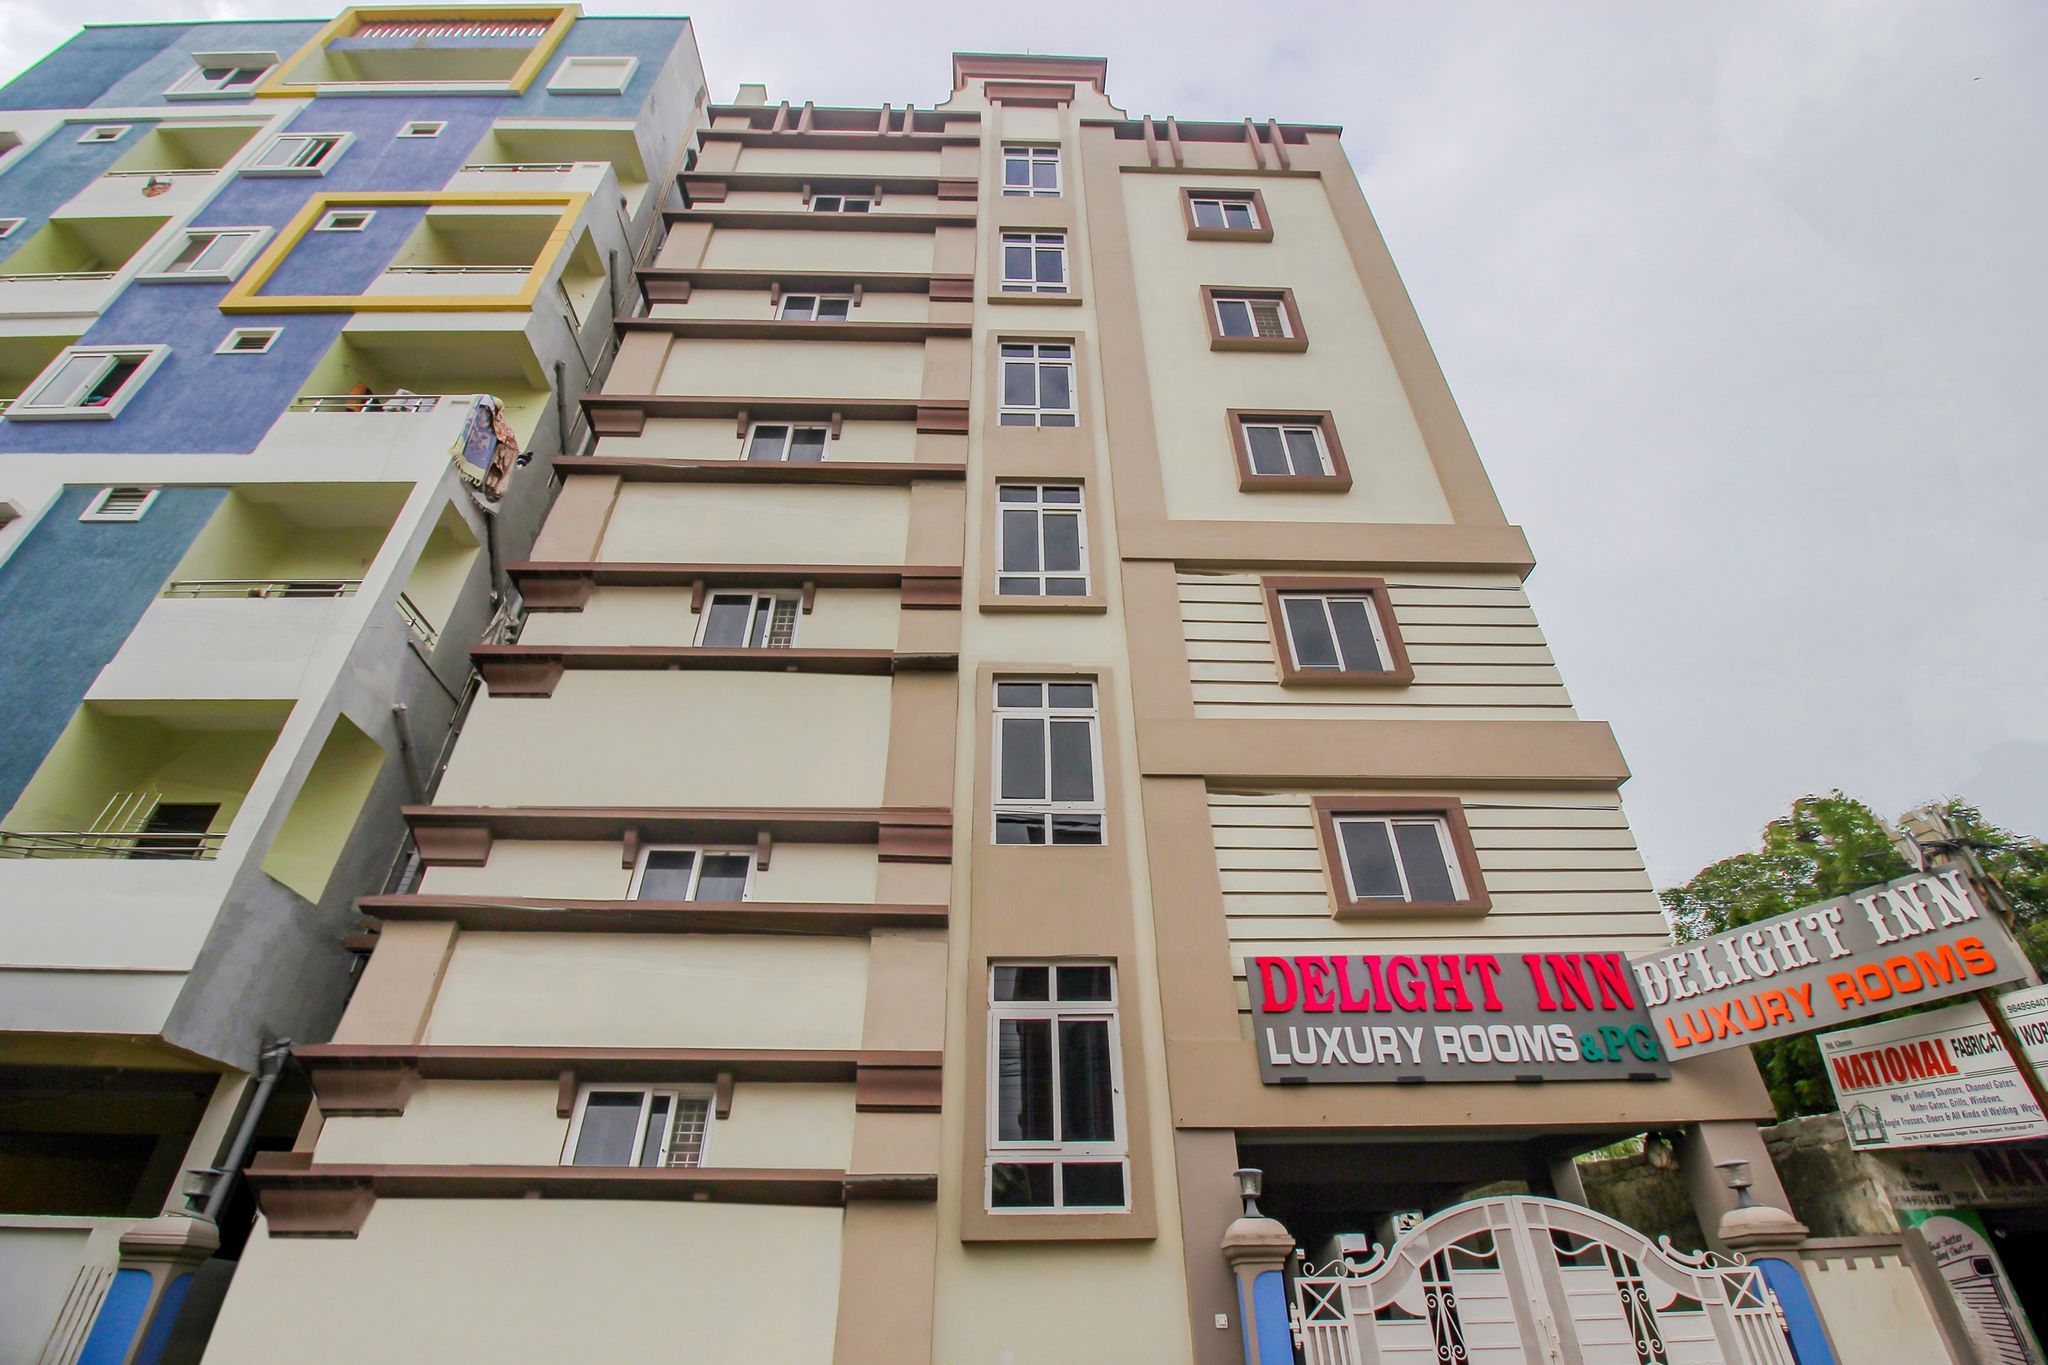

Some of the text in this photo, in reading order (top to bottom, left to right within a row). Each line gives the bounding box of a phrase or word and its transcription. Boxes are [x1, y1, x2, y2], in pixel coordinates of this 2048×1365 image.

[1633, 869, 1979, 1007] DELIGHT INN
[1255, 953, 1636, 1012] DELIGHT INN
[1664, 936, 1998, 1048] LUXURY ROOMS
[1266, 1026, 1423, 1065] LUXURY
[1434, 1024, 1580, 1064] ROOMS
[1832, 1038, 1959, 1091] NATIONAL
[1914, 1089, 1936, 1100] Rolling
[1965, 1081, 1993, 1093] Channel
[1926, 1114, 1944, 1124] Doors
[1951, 1111, 1962, 1121] All
[1962, 1109, 1981, 1119] Kinds
[1982, 1107, 1990, 1117] of
[1990, 1105, 2018, 1117] Welding
